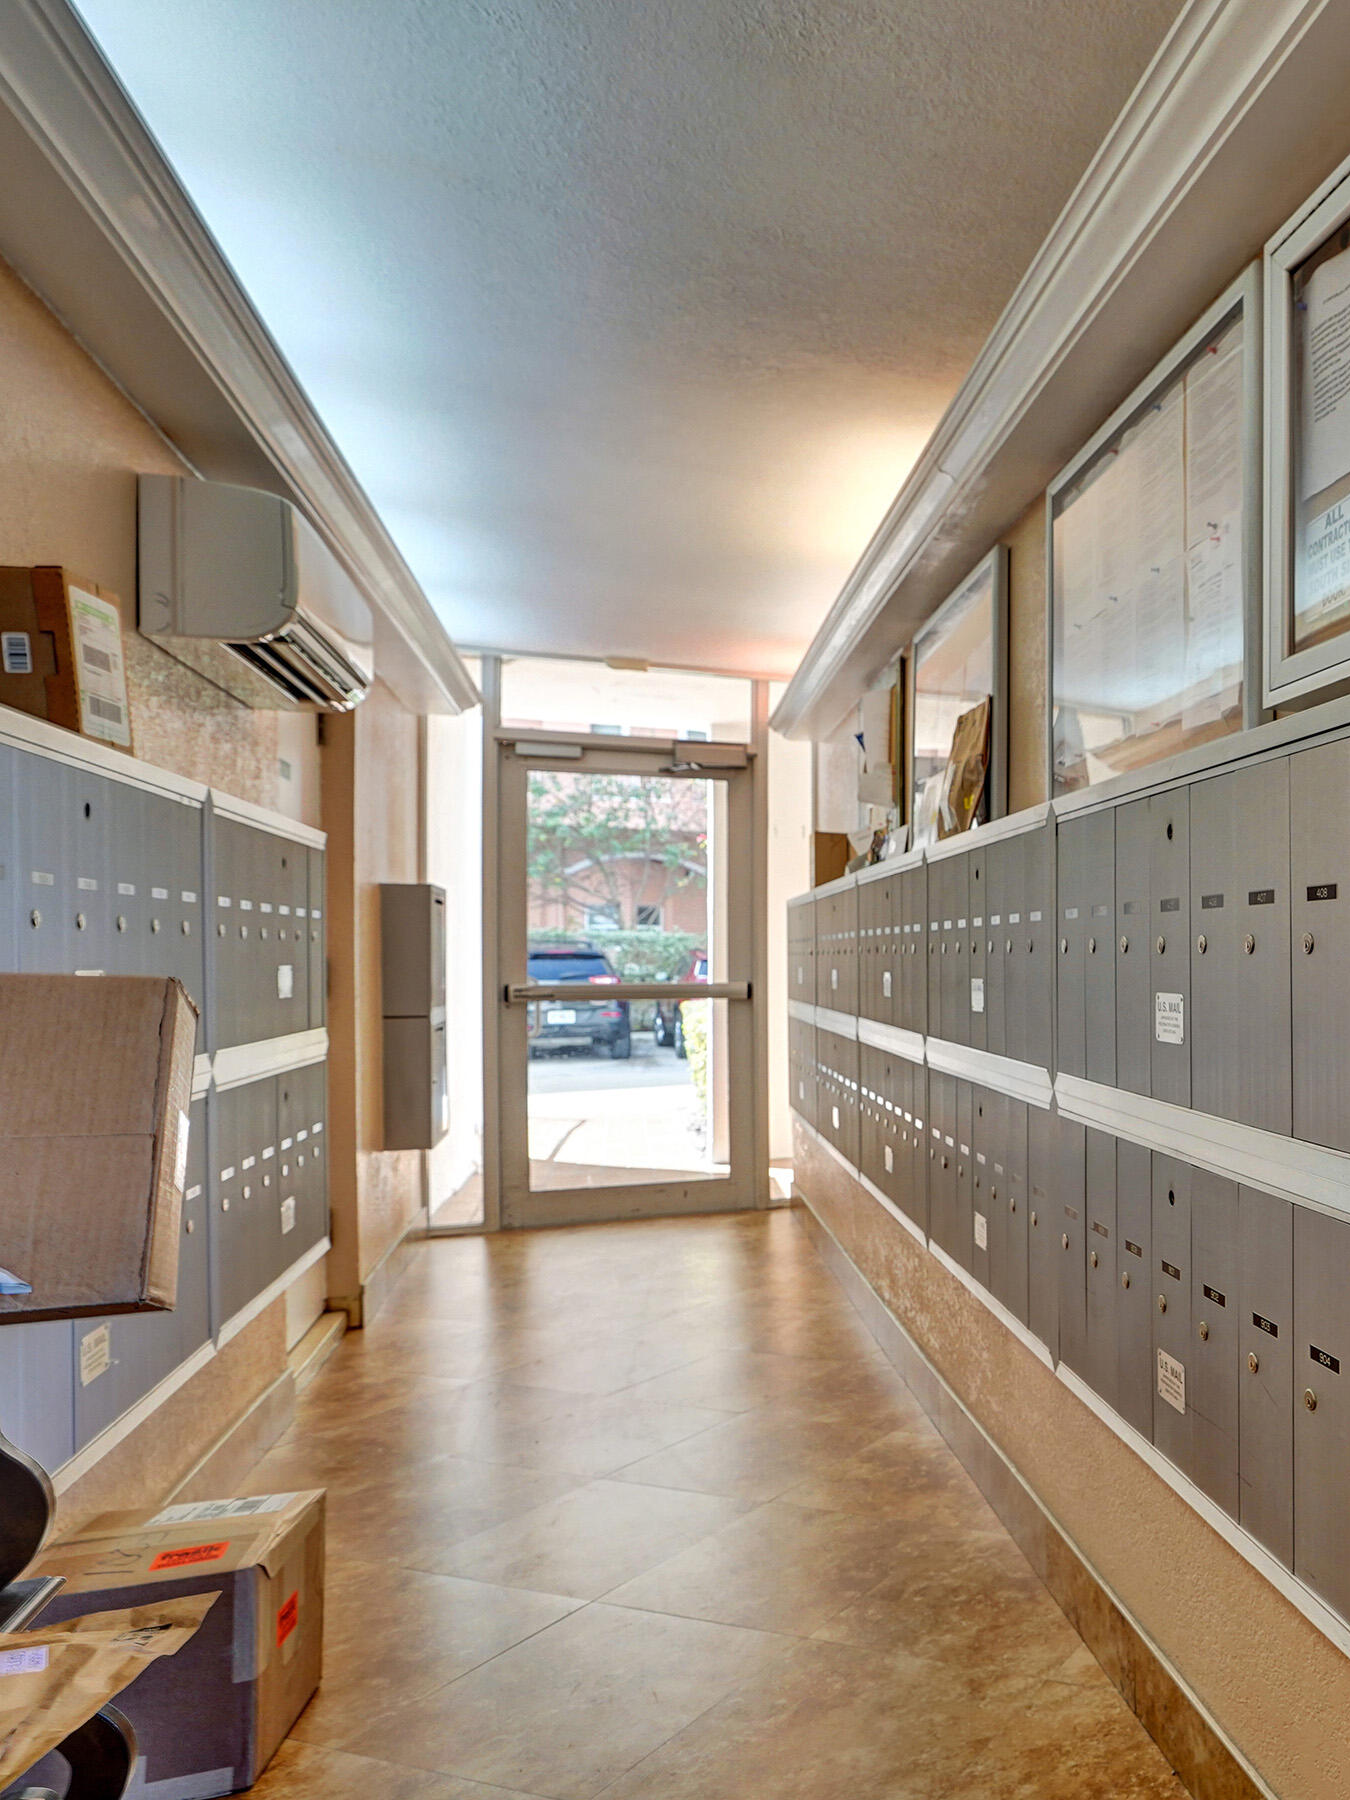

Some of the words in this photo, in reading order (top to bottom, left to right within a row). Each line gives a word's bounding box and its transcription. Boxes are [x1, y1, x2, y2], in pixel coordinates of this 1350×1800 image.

[1324, 504, 1345, 530] ALL
[1331, 542, 1346, 566] USE
[1316, 887, 1328, 898] 408
[1260, 1319, 1270, 1331] 903
[1319, 1353, 1330, 1366] 904
